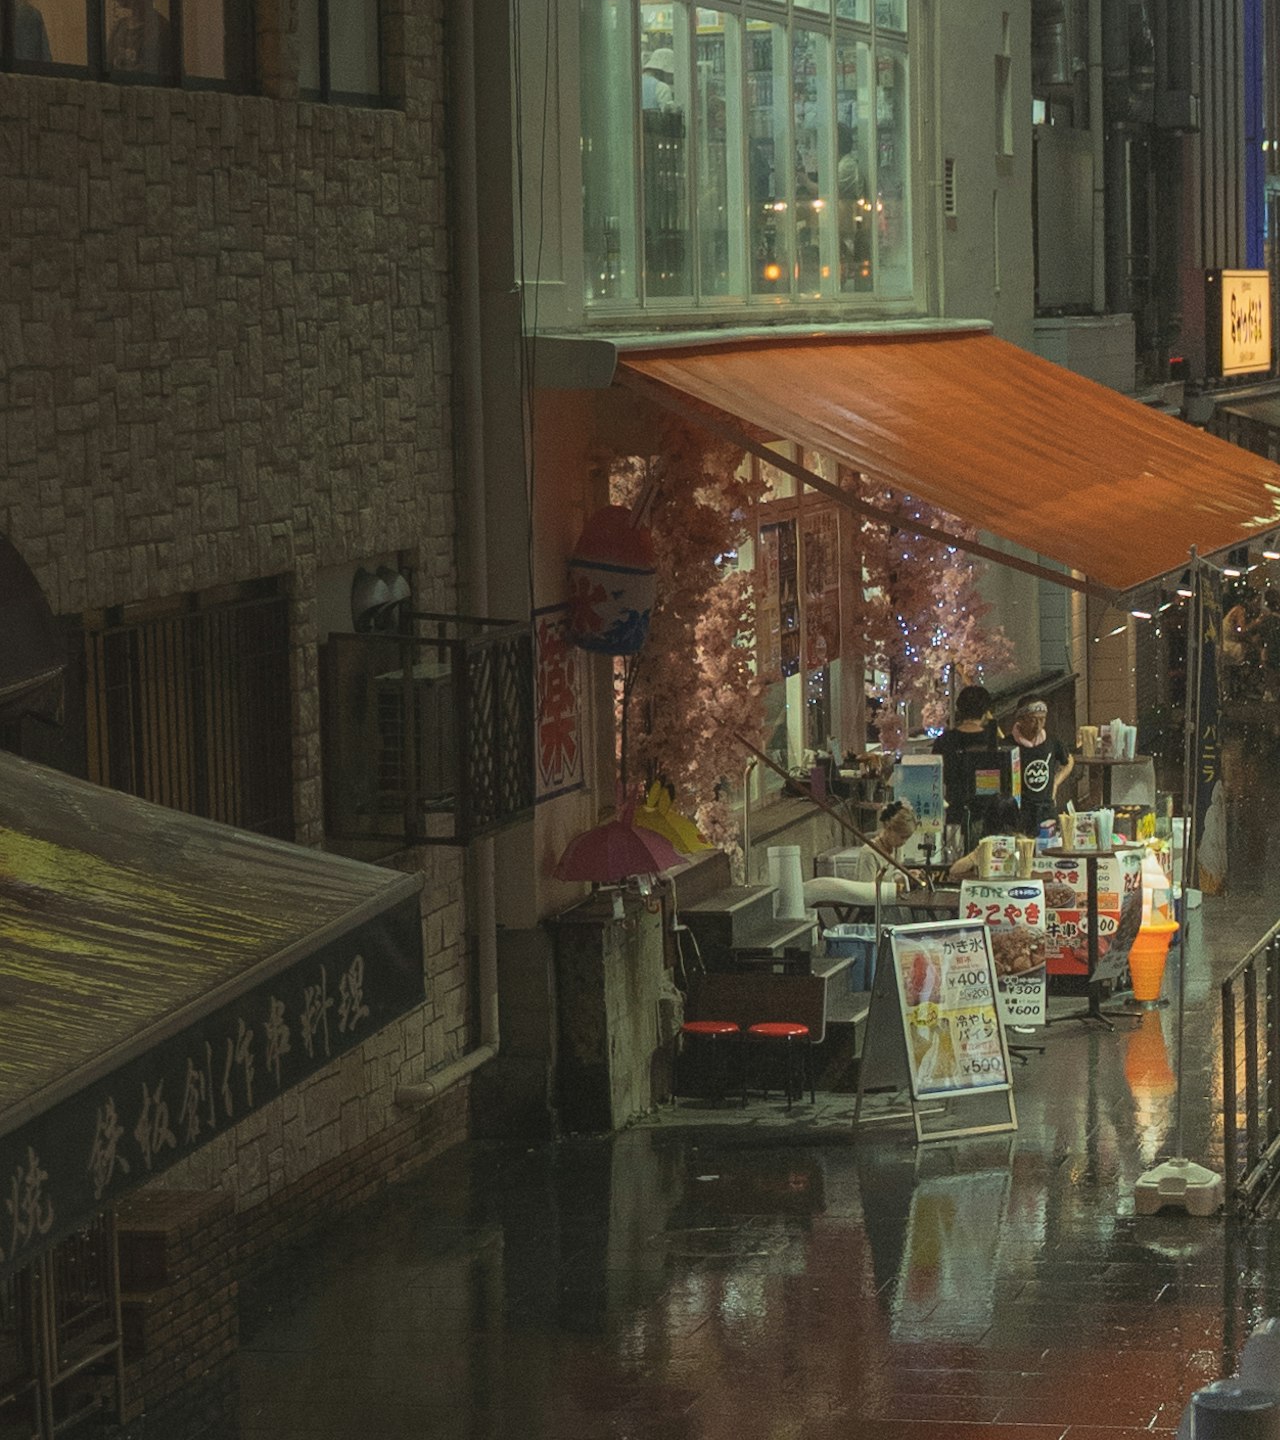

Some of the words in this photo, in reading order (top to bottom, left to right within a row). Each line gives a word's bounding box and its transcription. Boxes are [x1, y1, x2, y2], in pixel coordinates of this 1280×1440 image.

[965, 901, 1040, 927] たこやき
[943, 938, 984, 955] かき氷
[949, 970, 987, 987] ¥400
[1008, 985, 1041, 995] ¥300
[1008, 1005, 1040, 1015] ¥600
